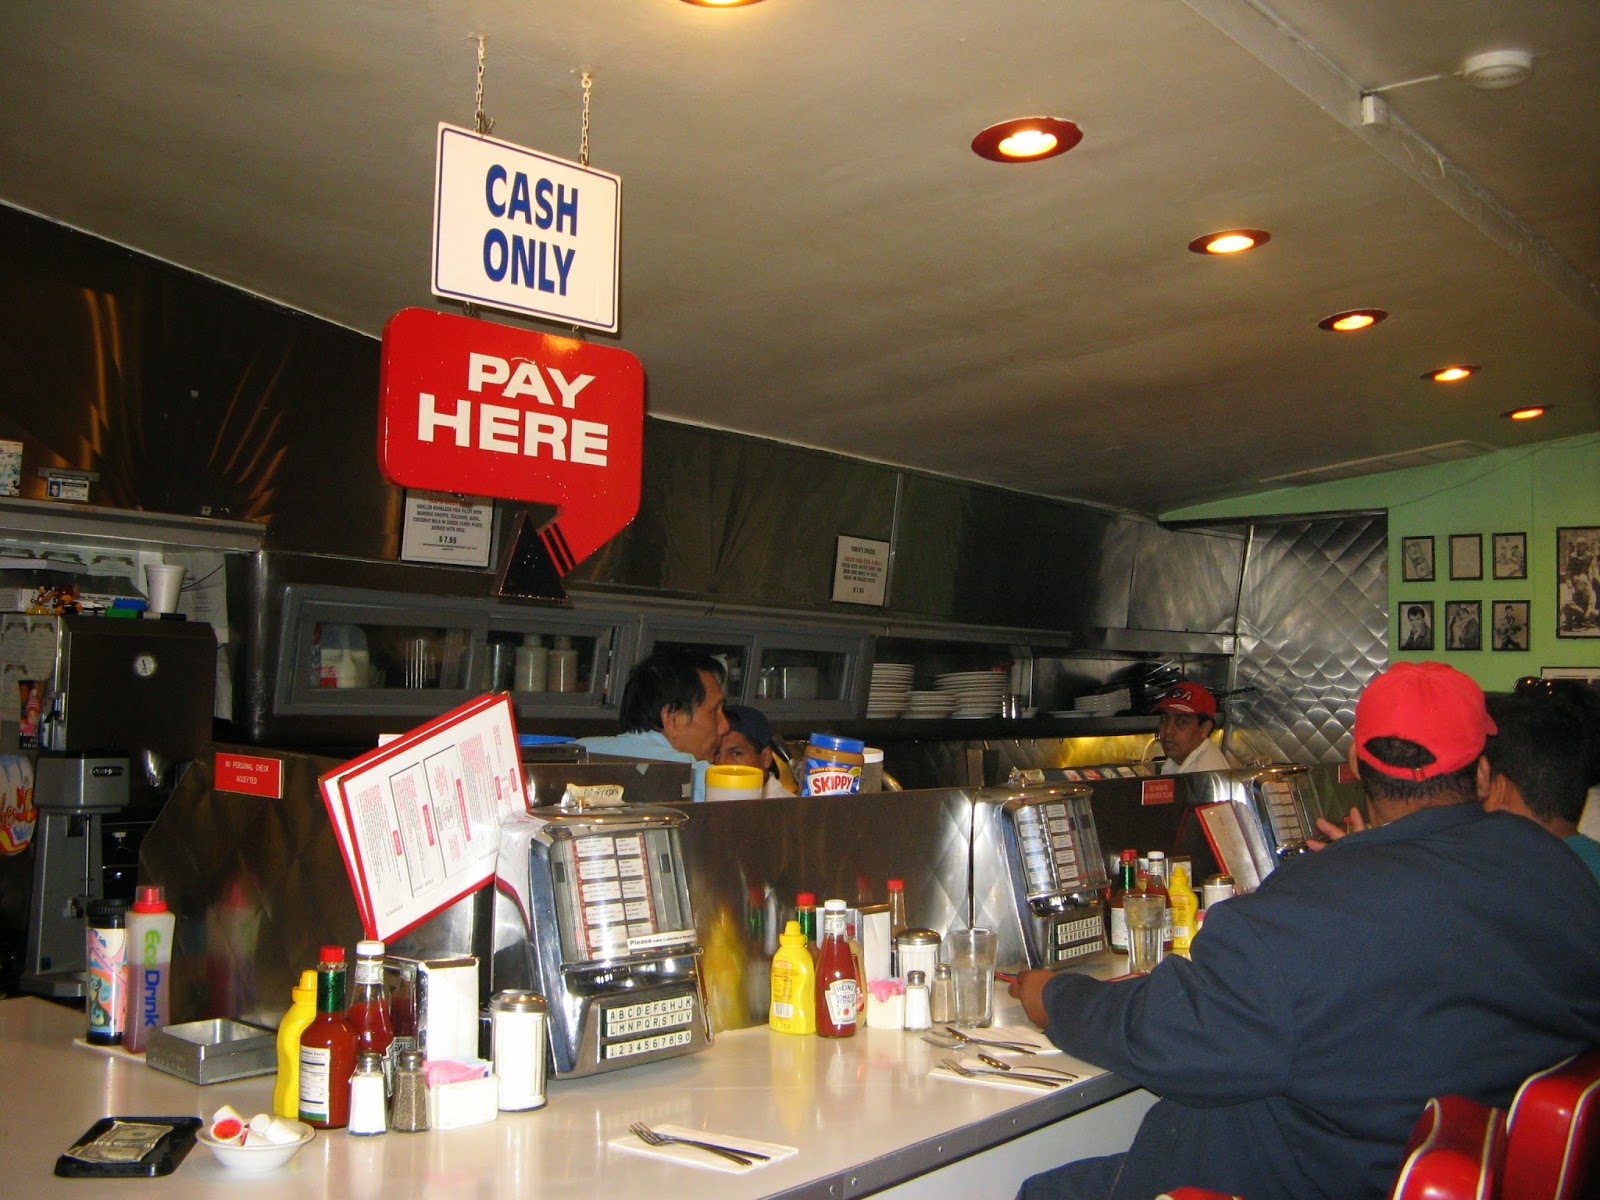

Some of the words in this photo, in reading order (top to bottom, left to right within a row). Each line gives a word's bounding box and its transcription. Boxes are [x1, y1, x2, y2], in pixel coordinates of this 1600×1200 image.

[485, 164, 578, 237] CASH
[483, 228, 576, 296] ONLY
[467, 352, 596, 409] PAY
[417, 392, 609, 467] HERE
[232, 761, 254, 771] PERSONAL
[255, 764, 270, 773] CHECK
[812, 775, 853, 794] SKIPPY
[630, 938, 652, 946] Please
[836, 984, 855, 993] HEINZ
[836, 993, 856, 1001] TOMATO
